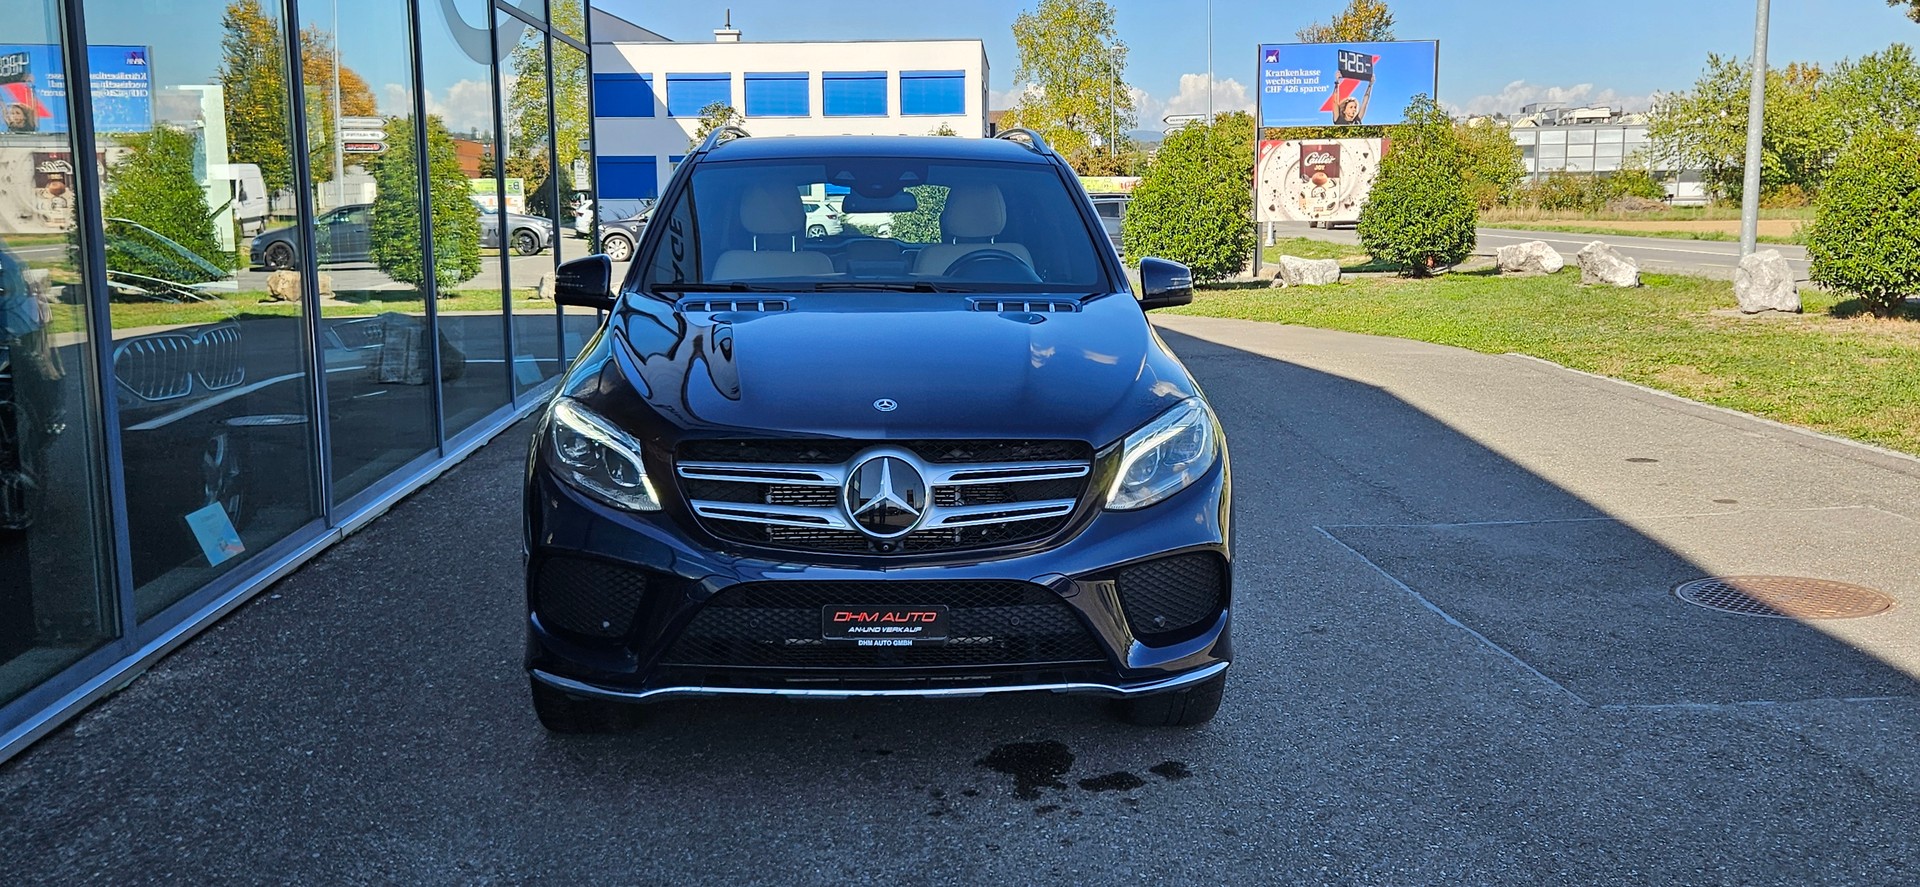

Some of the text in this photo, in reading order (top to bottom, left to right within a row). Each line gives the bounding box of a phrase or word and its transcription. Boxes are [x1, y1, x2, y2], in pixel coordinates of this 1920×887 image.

[1265, 68, 1321, 77] Krankenkasse
[1265, 76, 1319, 85] wechseln und
[1265, 85, 1283, 93] CHF
[1284, 85, 1299, 93] 426
[833, 611, 937, 622] DHM AUTO
